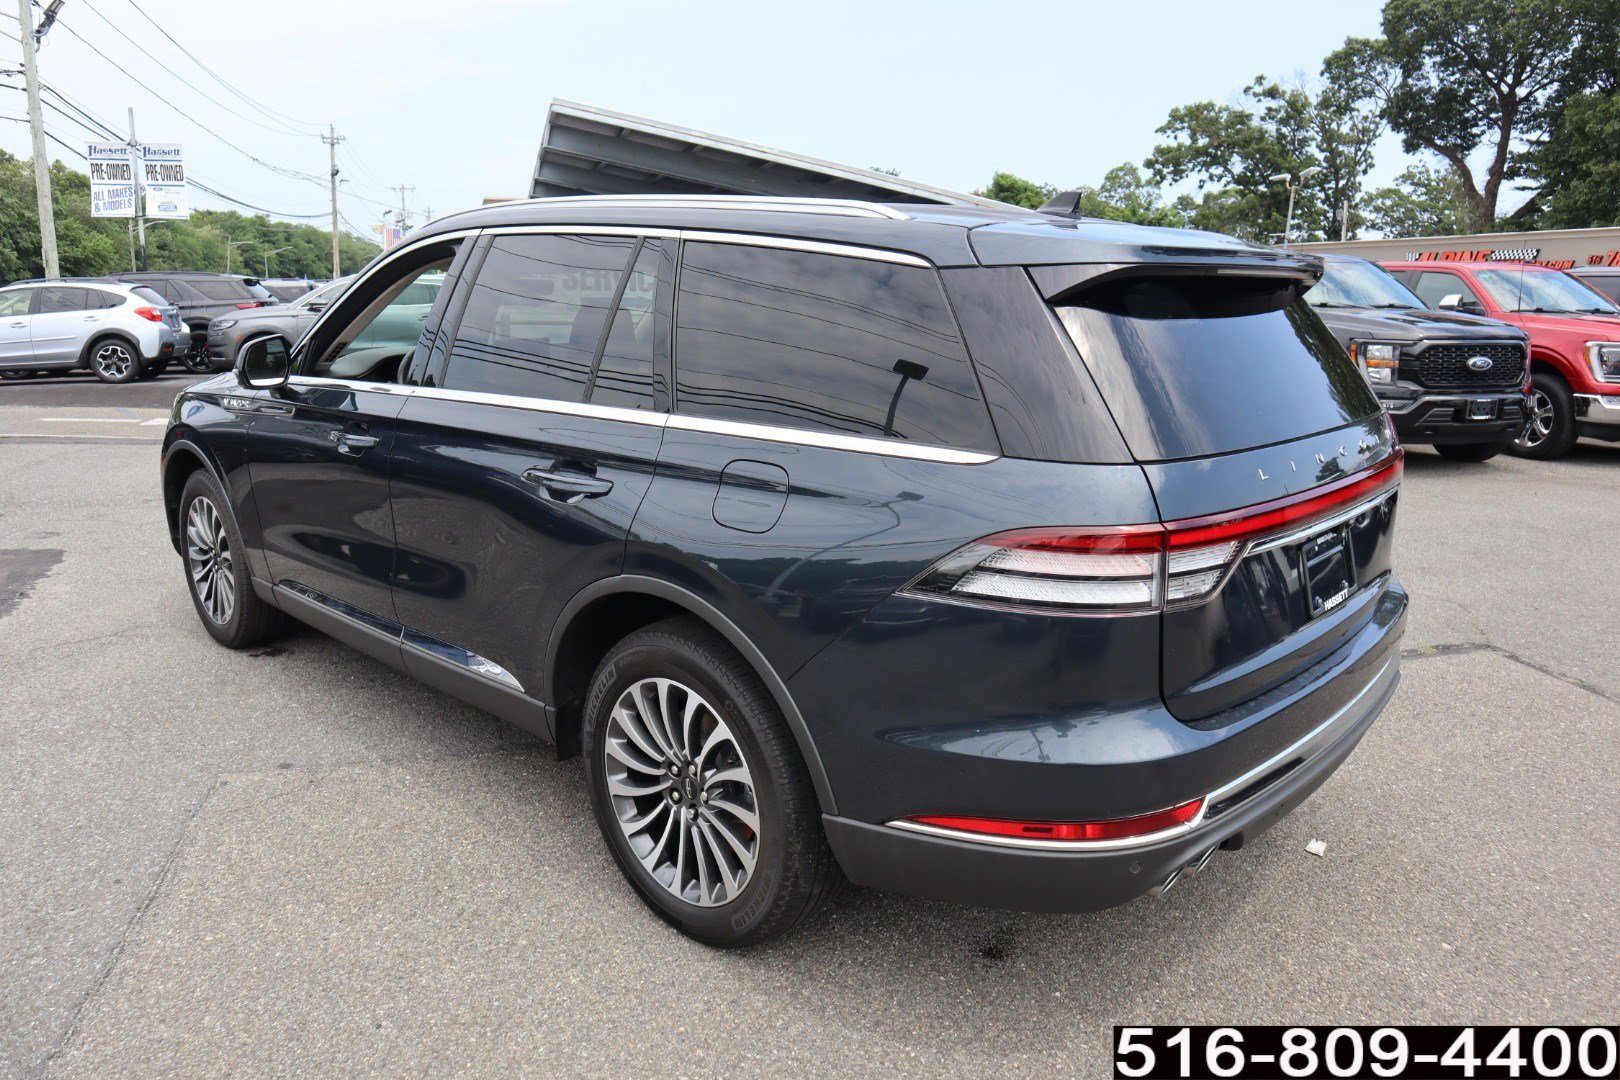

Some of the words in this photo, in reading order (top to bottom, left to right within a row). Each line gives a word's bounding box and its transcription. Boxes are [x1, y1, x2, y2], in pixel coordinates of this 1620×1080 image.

[90, 163, 132, 181] PRE-OWNED
[145, 164, 184, 182] PRE-OWNED
[93, 191, 107, 202] ALL
[107, 186, 134, 200] MAKES
[94, 203, 101, 213] &
[102, 198, 133, 212] MODELS
[561, 269, 655, 292] SERVIC
[1324, 588, 1348, 611] HASSETT
